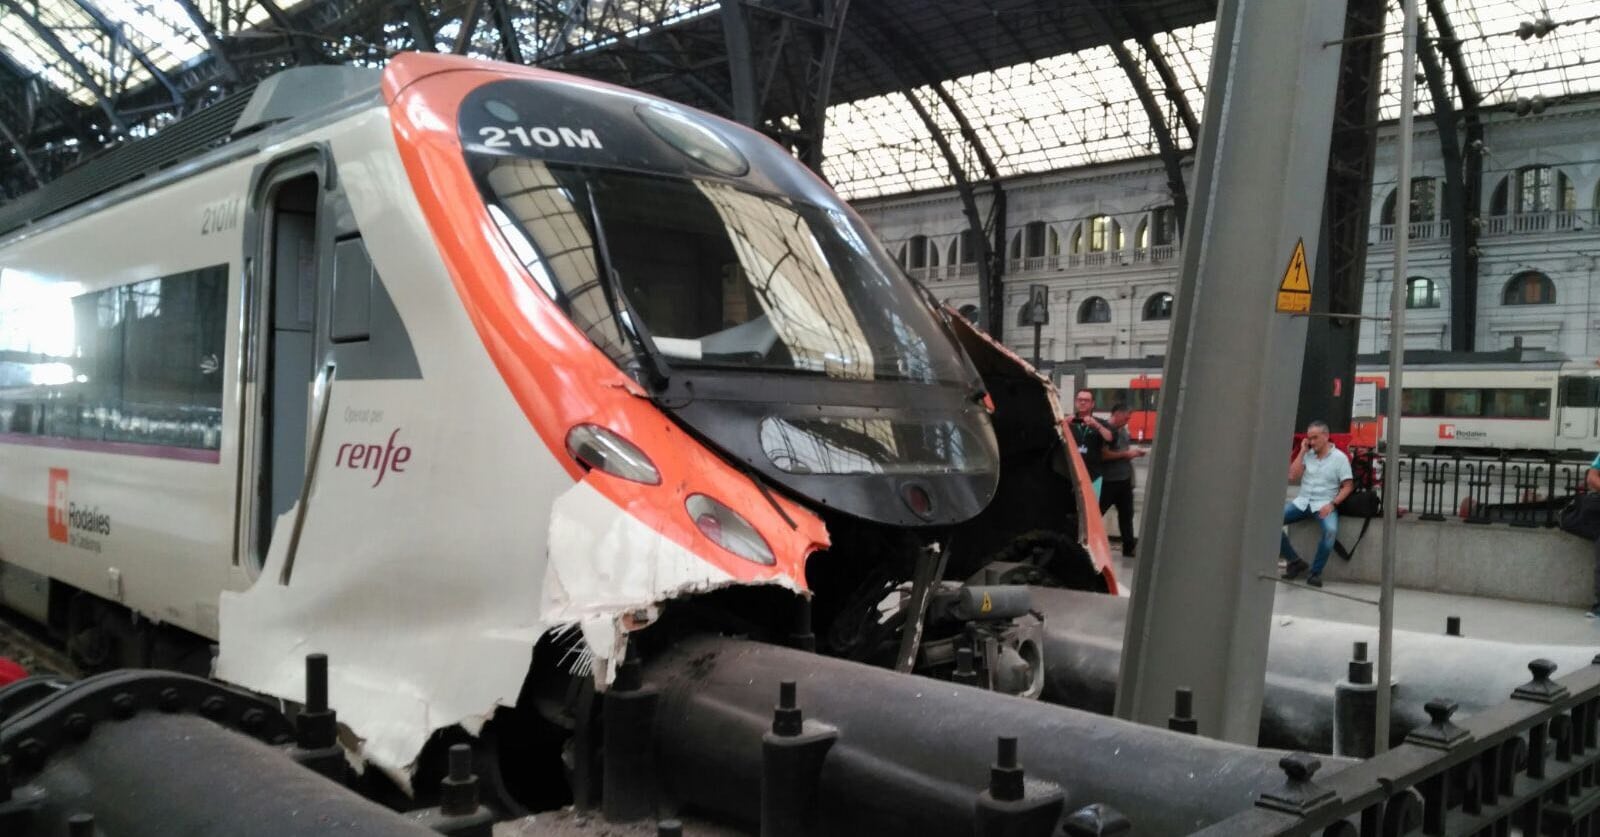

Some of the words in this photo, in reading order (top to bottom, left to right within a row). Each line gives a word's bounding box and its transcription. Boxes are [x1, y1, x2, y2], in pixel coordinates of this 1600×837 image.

[479, 126, 603, 149] 210M
[201, 198, 240, 235] 210M
[335, 427, 411, 488] renfe
[69, 502, 110, 535] Rodalies
